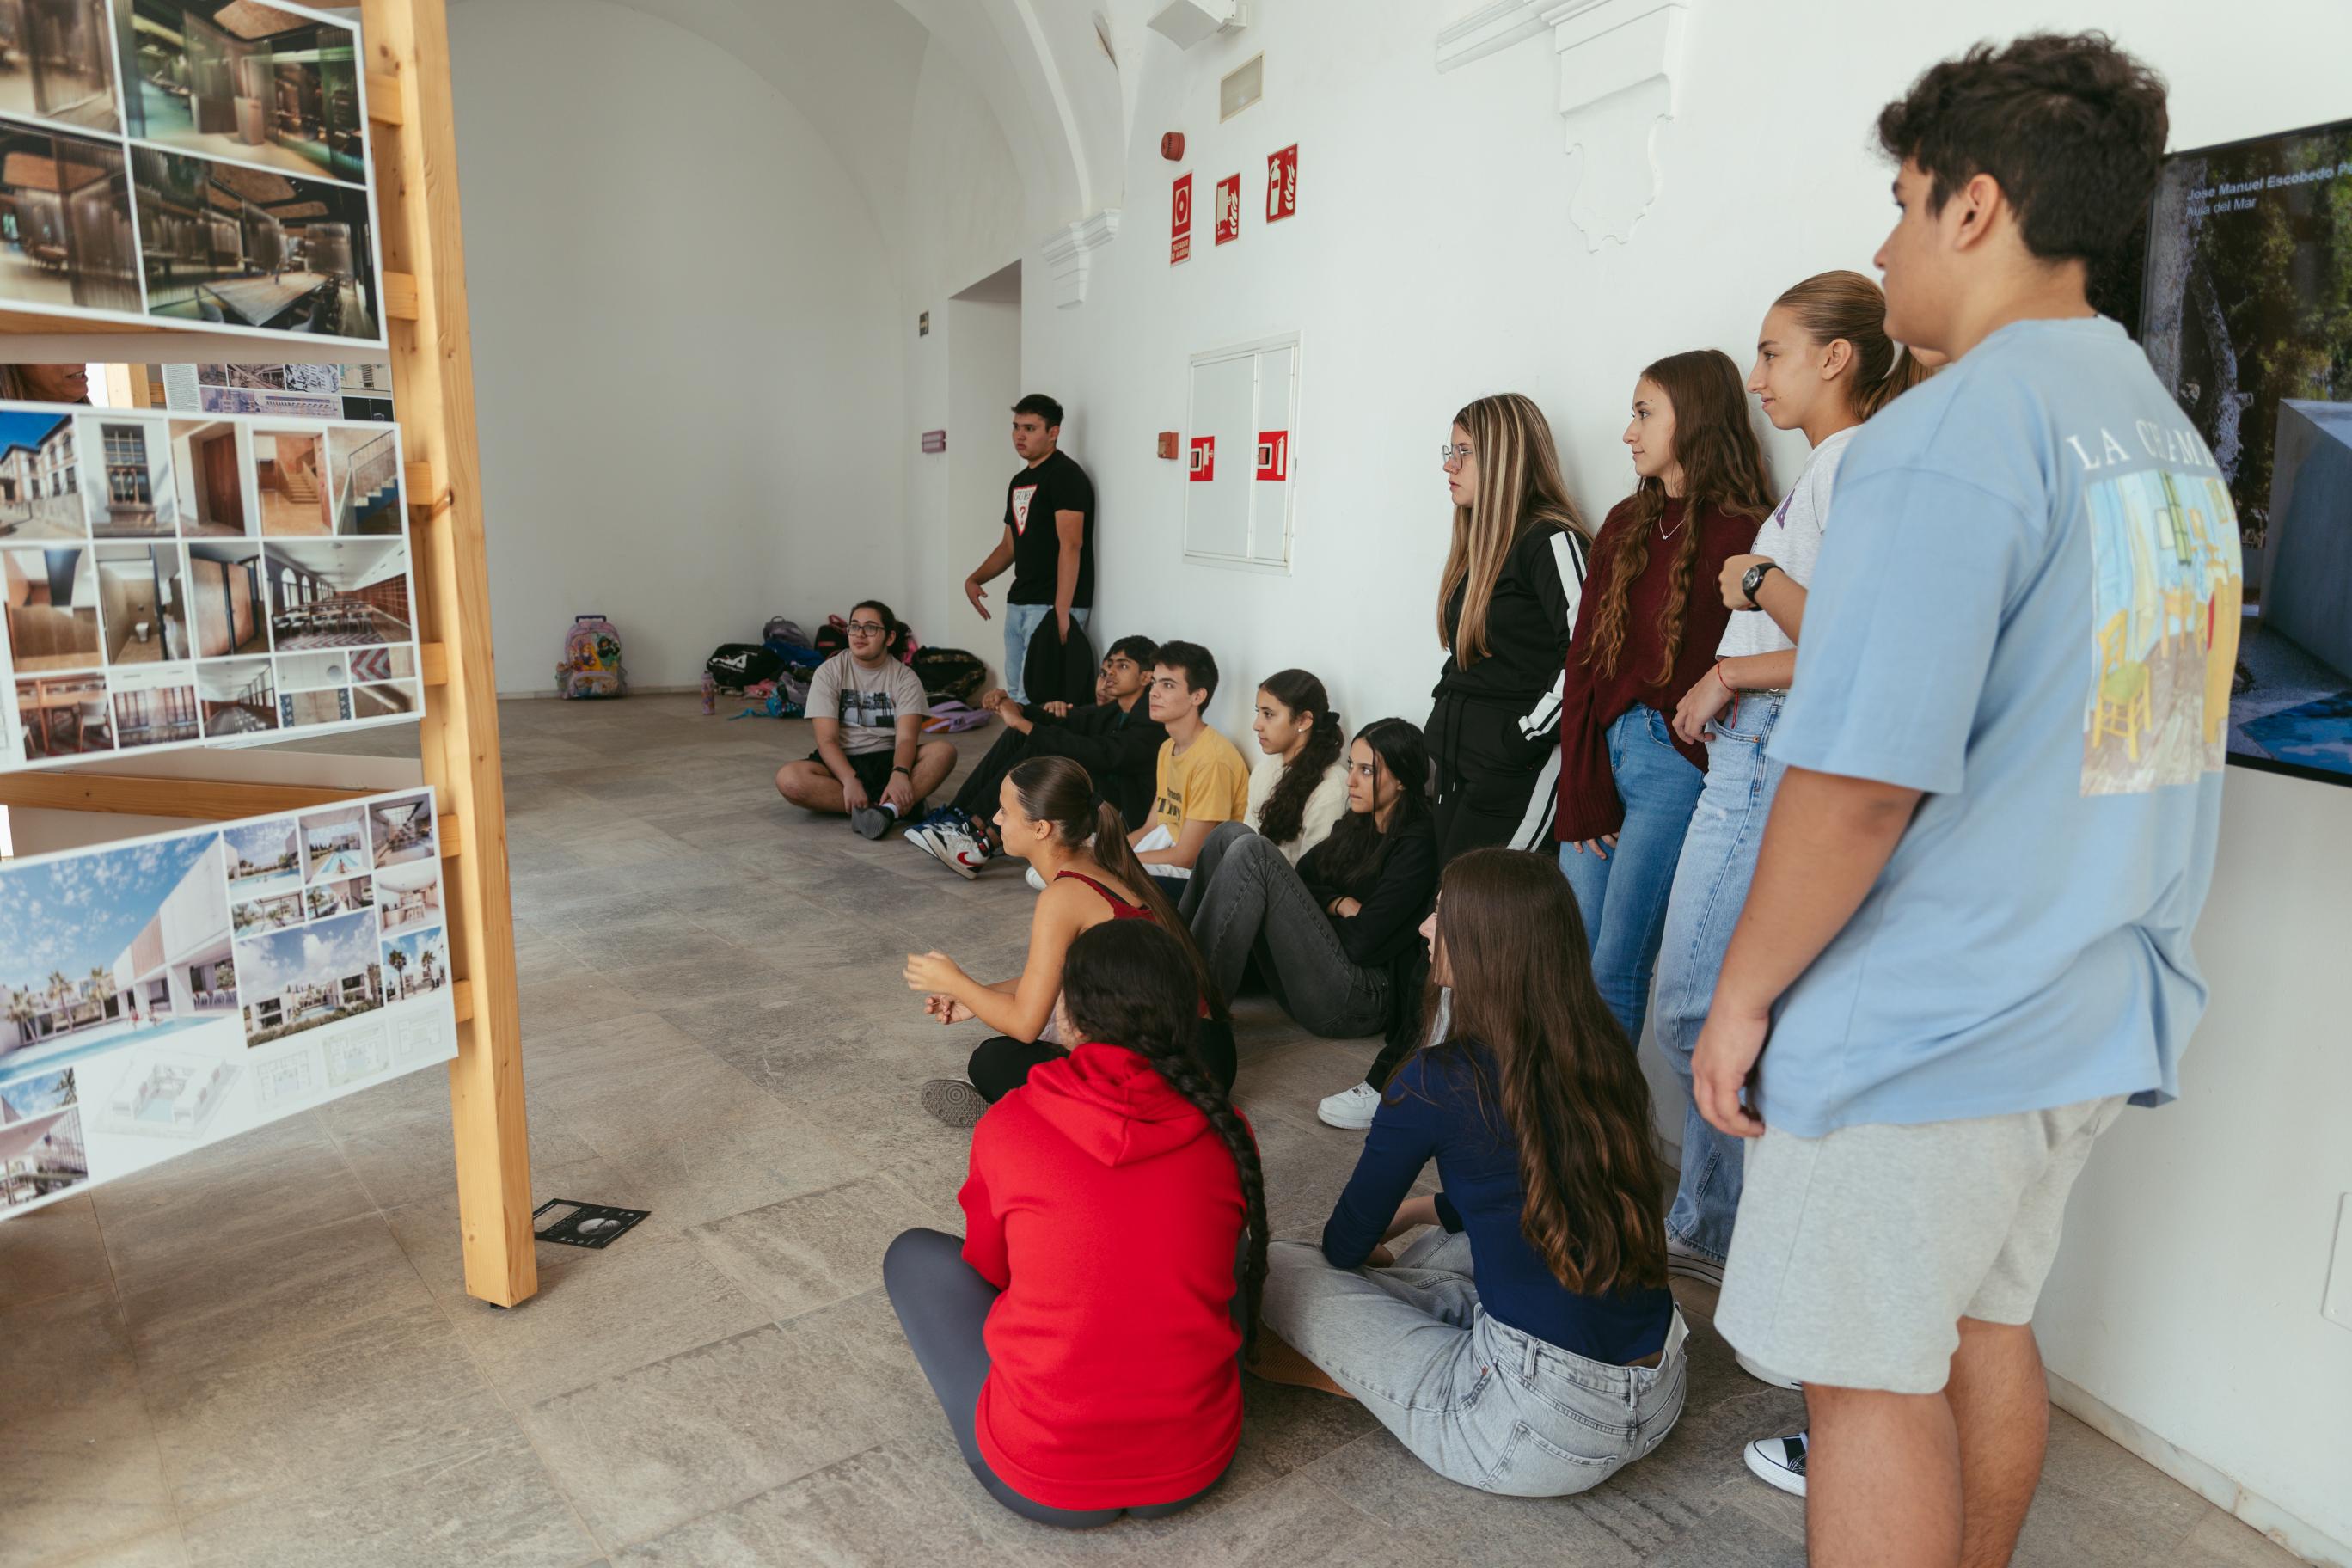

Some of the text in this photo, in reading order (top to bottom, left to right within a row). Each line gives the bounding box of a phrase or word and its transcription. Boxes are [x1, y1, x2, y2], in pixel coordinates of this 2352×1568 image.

[2187, 188, 2215, 201] Jose
[2219, 177, 2263, 196] Manuel
[2267, 168, 2335, 188] Escobedo
[2186, 198, 2257, 217] Aula del Mar
[2066, 427, 2131, 469] LA
